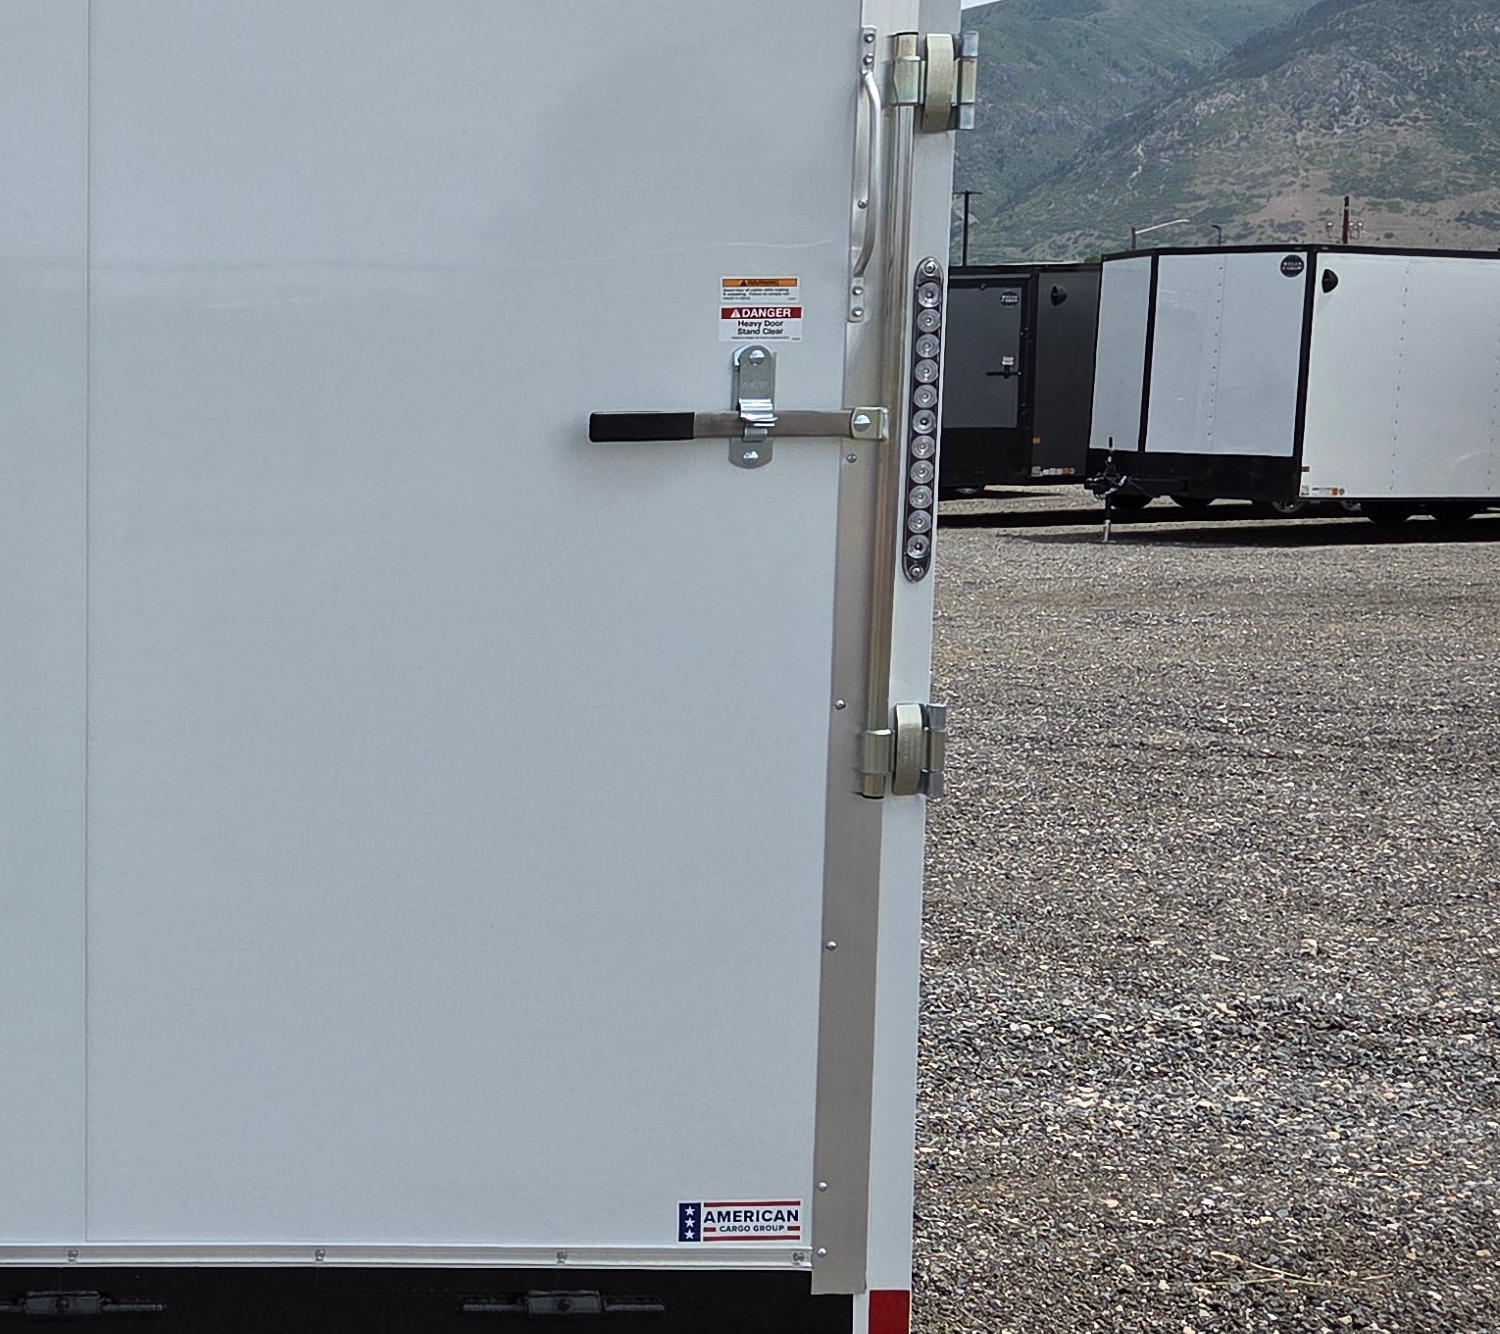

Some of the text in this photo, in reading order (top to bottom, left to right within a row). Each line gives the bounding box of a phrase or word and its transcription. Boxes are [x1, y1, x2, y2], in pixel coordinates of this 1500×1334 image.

[742, 308, 791, 318] DANGER
[738, 320, 762, 329] Heavy
[703, 1209, 799, 1223] AMERICAN
[720, 1224, 785, 1233] CARGO GROUP
